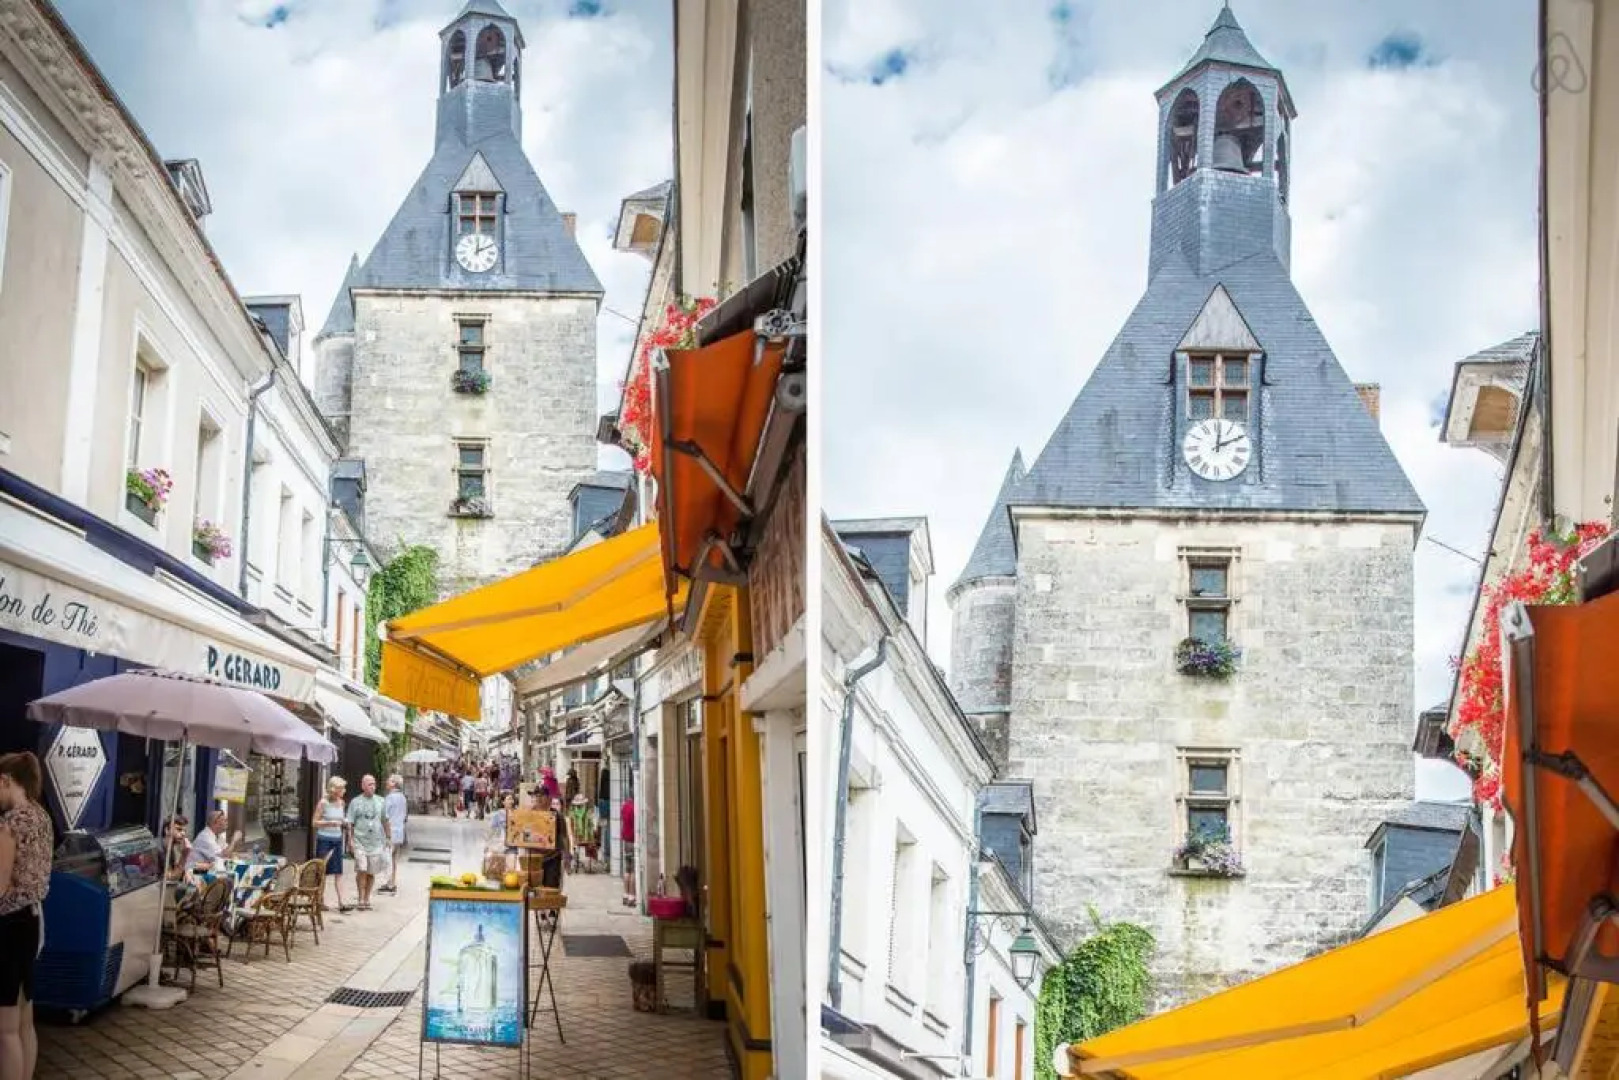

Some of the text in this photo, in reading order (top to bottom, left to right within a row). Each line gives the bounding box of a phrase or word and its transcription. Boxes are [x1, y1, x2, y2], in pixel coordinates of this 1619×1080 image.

[32, 593, 56, 625] de
[62, 602, 99, 637] Thé
[207, 644, 281, 690] P. GERARD
